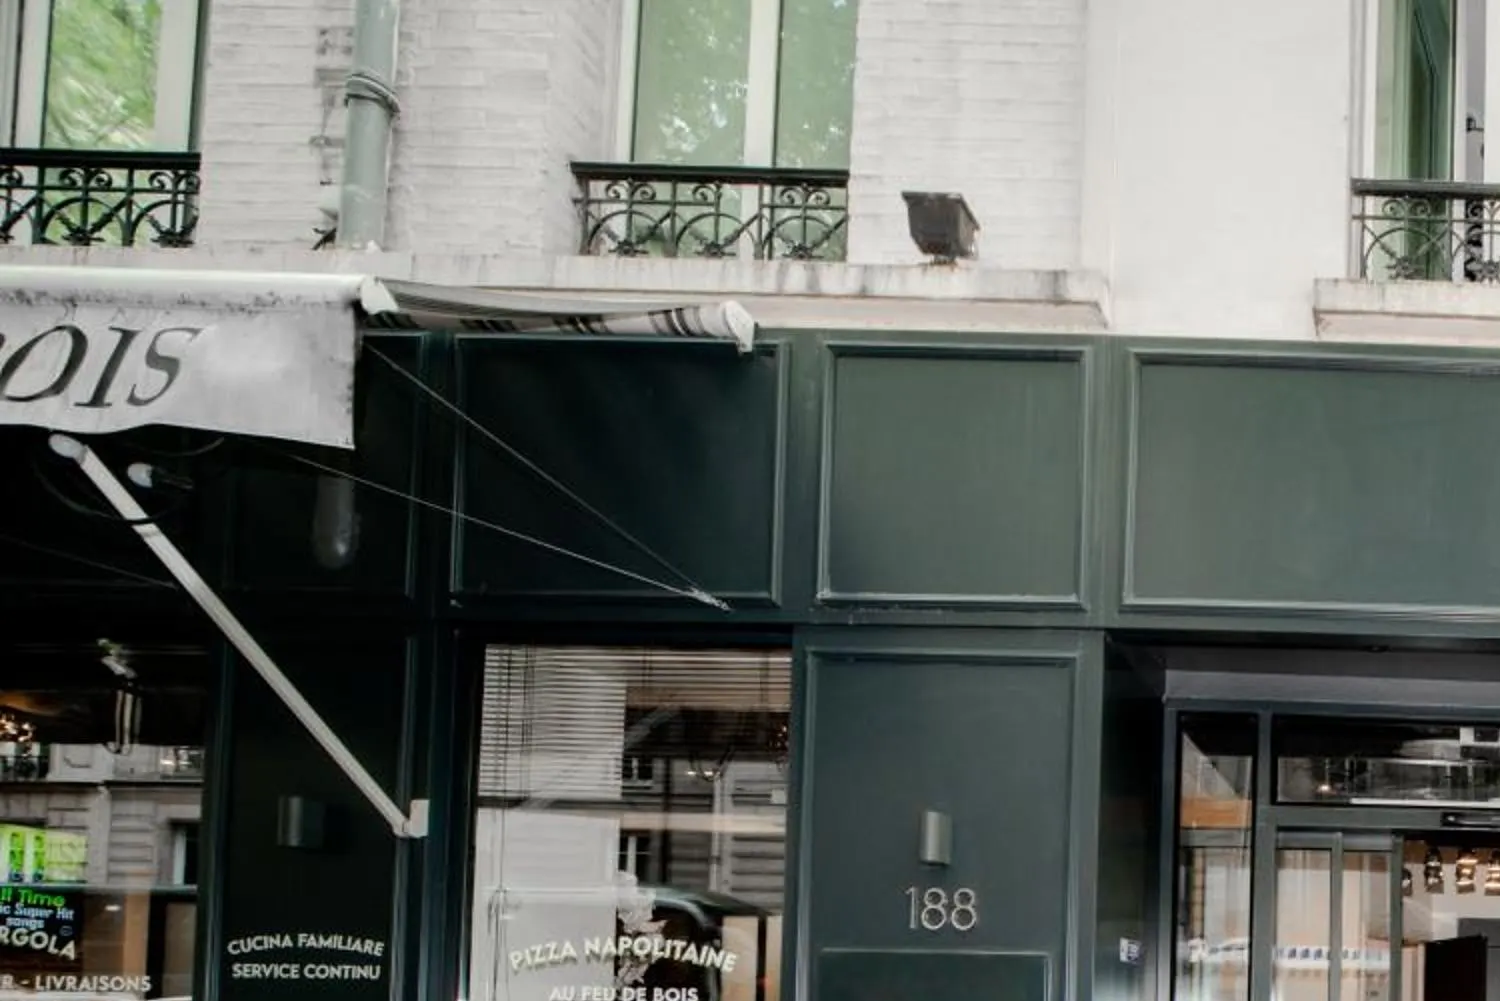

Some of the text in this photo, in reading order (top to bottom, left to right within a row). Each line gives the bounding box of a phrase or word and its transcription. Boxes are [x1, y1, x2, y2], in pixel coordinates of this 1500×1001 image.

[0, 325, 204, 408] OIS
[904, 886, 977, 931] 188
[227, 933, 385, 957] CUCINA FAMILIARE
[508, 936, 738, 973] PIZZA NAPOLITAINE
[231, 962, 381, 980] SERVICE CONTINU
[35, 975, 152, 992] LIVRAISONS
[549, 987, 575, 1001] AU
[581, 986, 617, 1001] FEU
